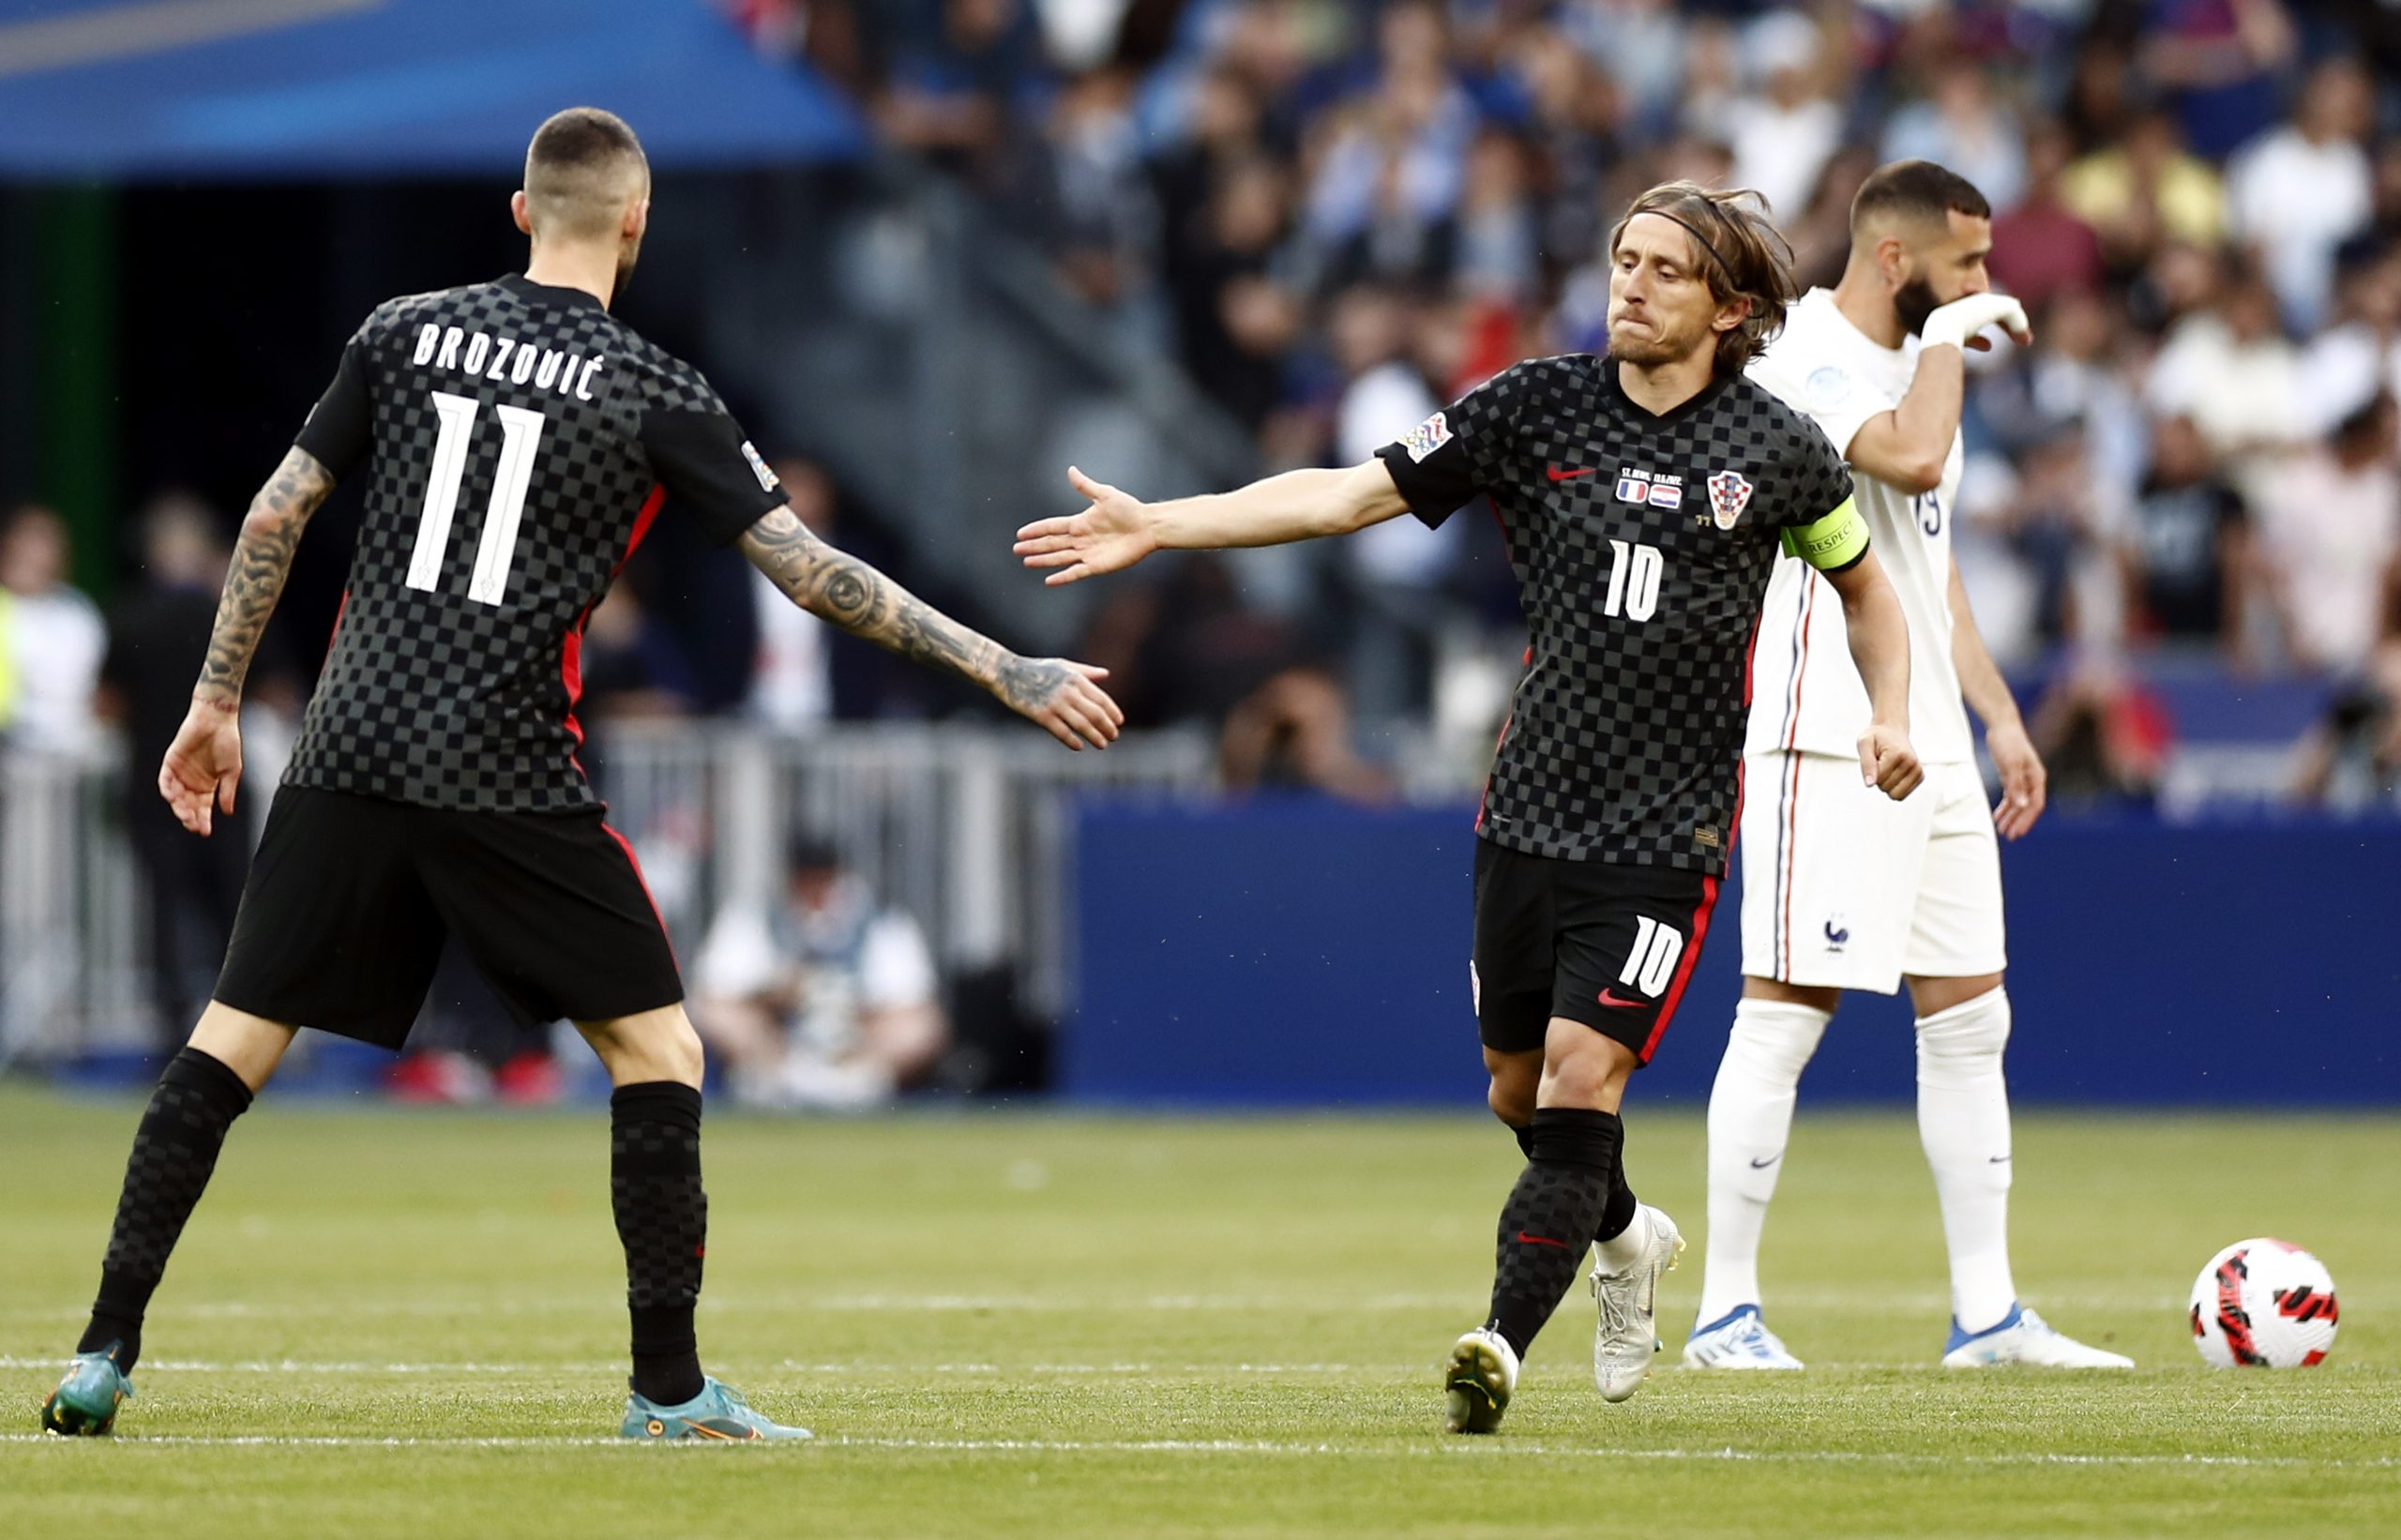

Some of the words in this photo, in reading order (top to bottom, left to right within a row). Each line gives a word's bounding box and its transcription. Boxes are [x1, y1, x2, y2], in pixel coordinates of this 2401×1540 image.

[413, 324, 604, 400] BROZOVIĆ
[405, 390, 546, 607] 11
[1808, 519, 1854, 554] RESPECT
[1604, 538, 1664, 623] 10
[1619, 914, 1684, 999] 10
